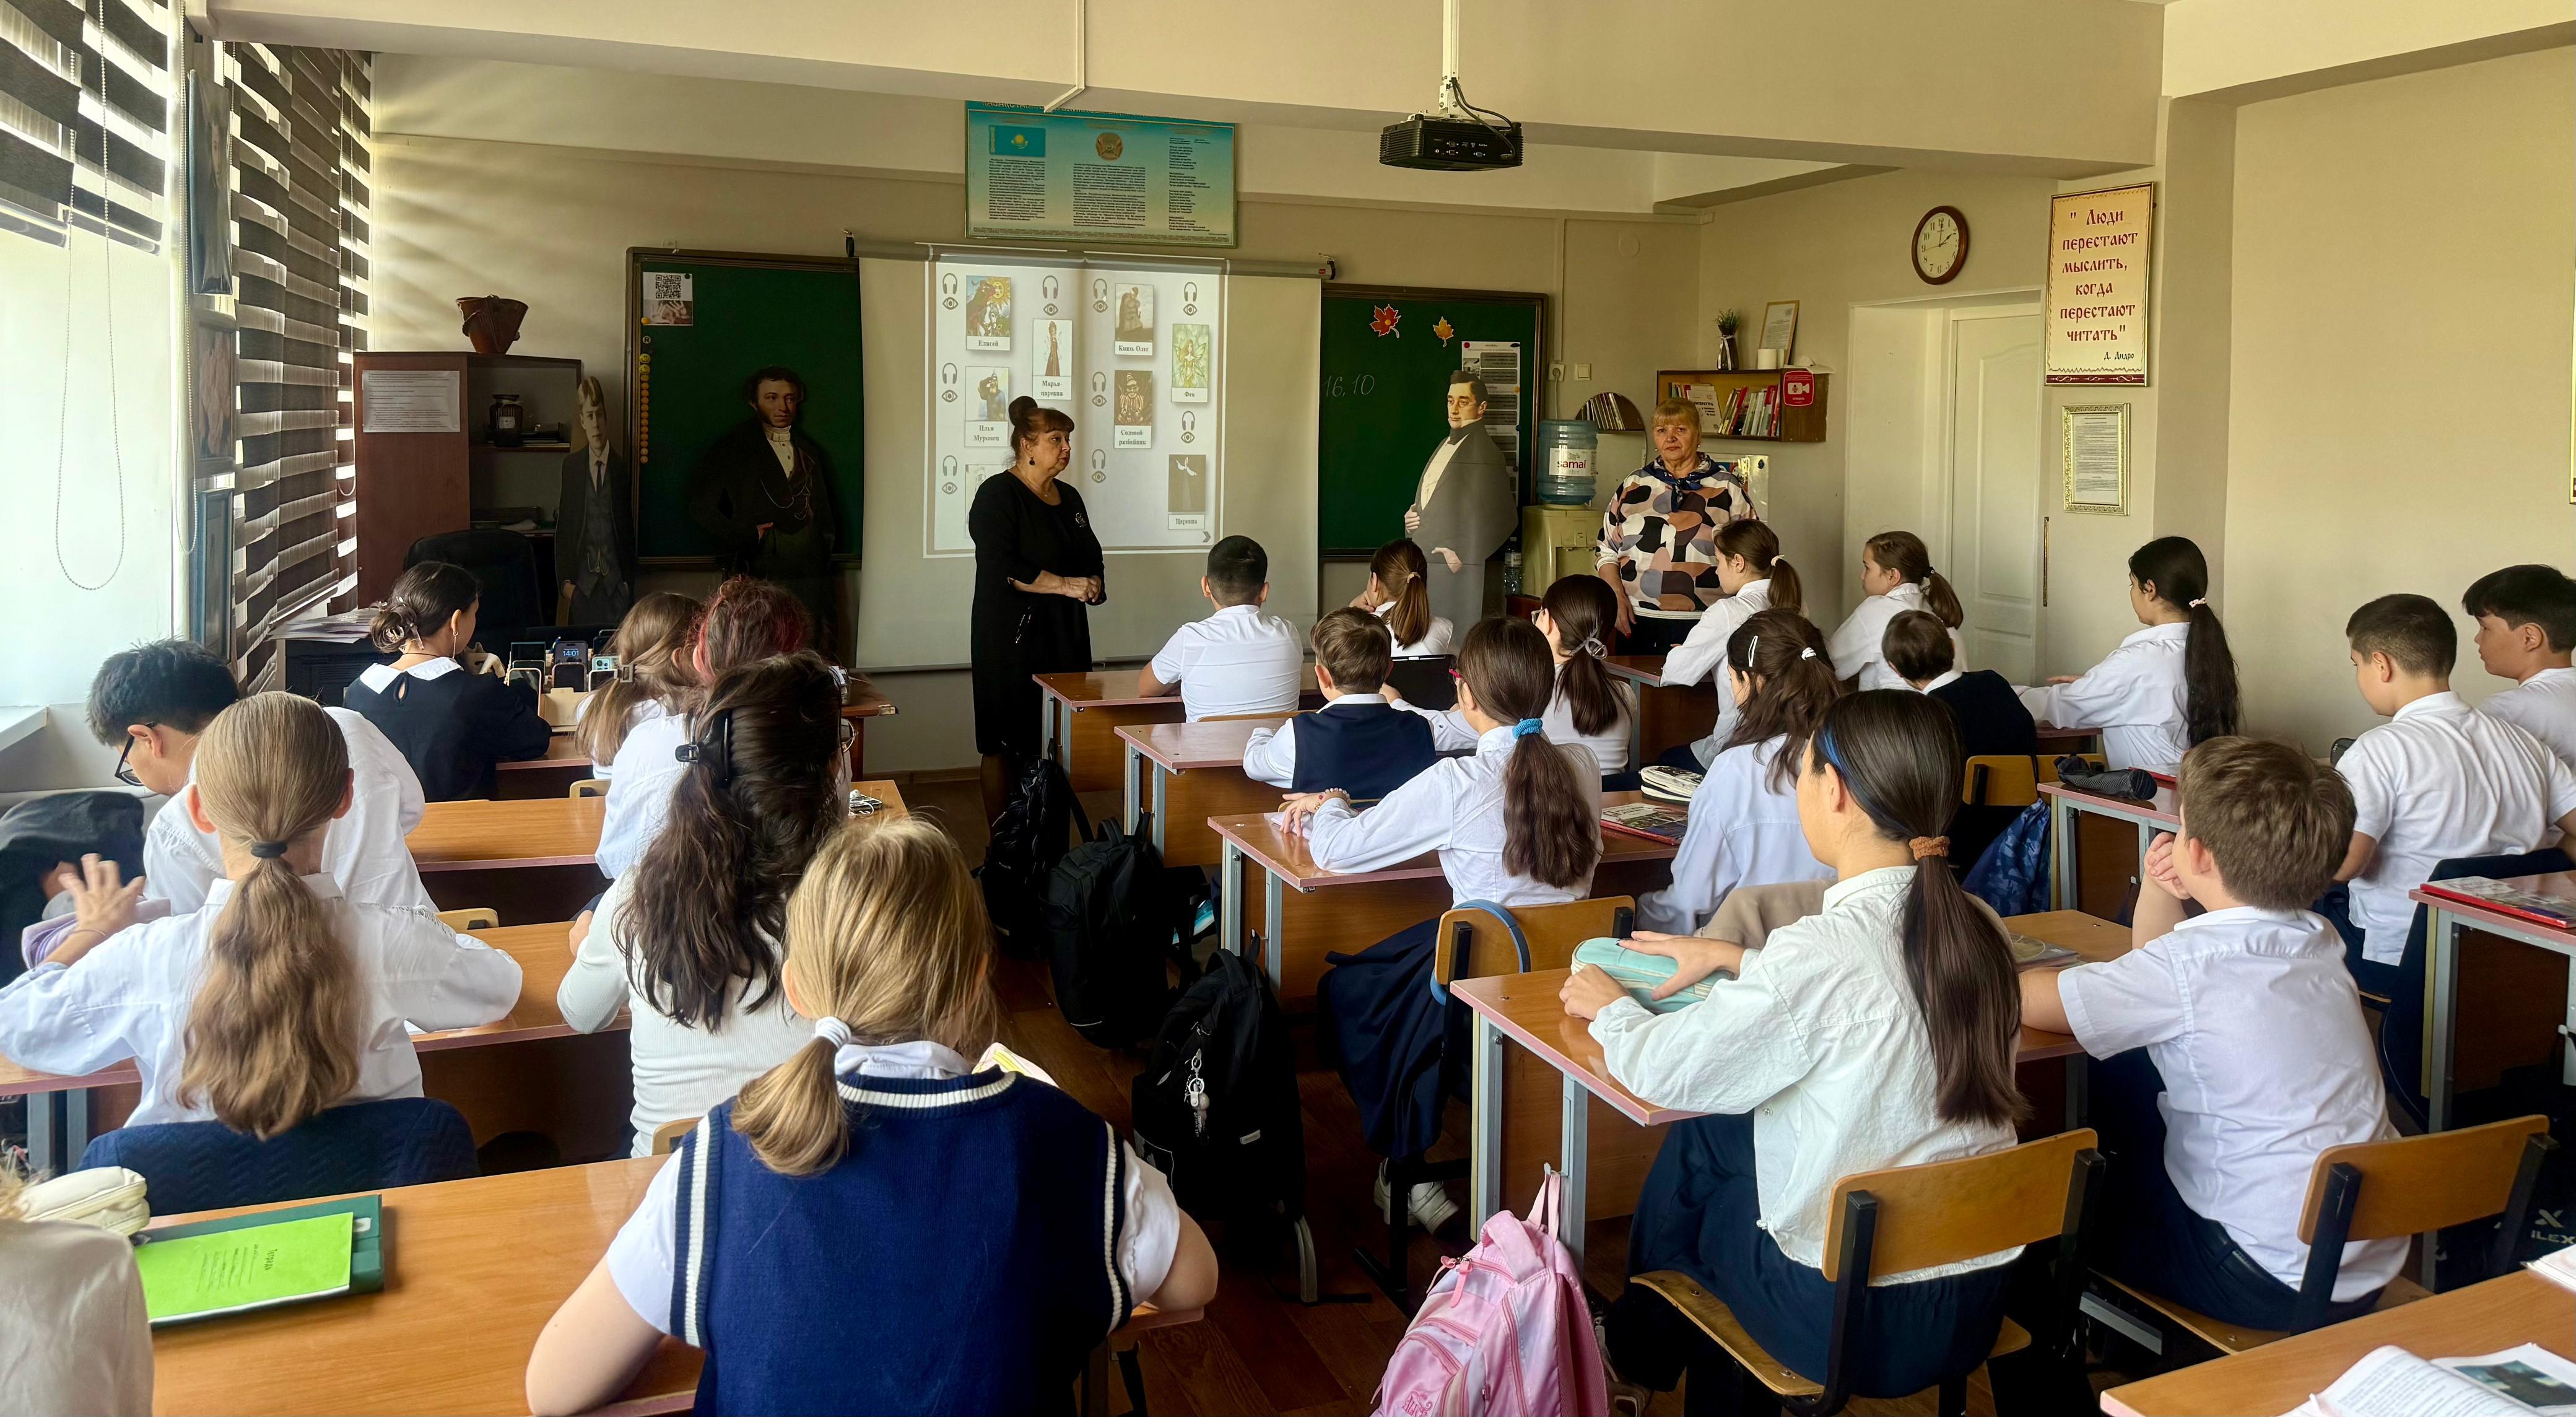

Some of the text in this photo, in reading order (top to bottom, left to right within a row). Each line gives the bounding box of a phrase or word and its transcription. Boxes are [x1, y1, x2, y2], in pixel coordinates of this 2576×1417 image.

[2086, 209, 2124, 226] Люди
[1930, 222, 1935, 231] 11
[1923, 232, 1930, 241] 10
[2062, 232, 2138, 255] перестают
[1930, 263, 1934, 272] 7
[2062, 258, 2128, 274] мыслить,
[2075, 282, 2113, 298] когда
[2060, 304, 2136, 323] перестают
[2066, 325, 2126, 342] читать"
[1557, 460, 1586, 469] samal
[264, 1249, 277, 1271] Тетрадь
